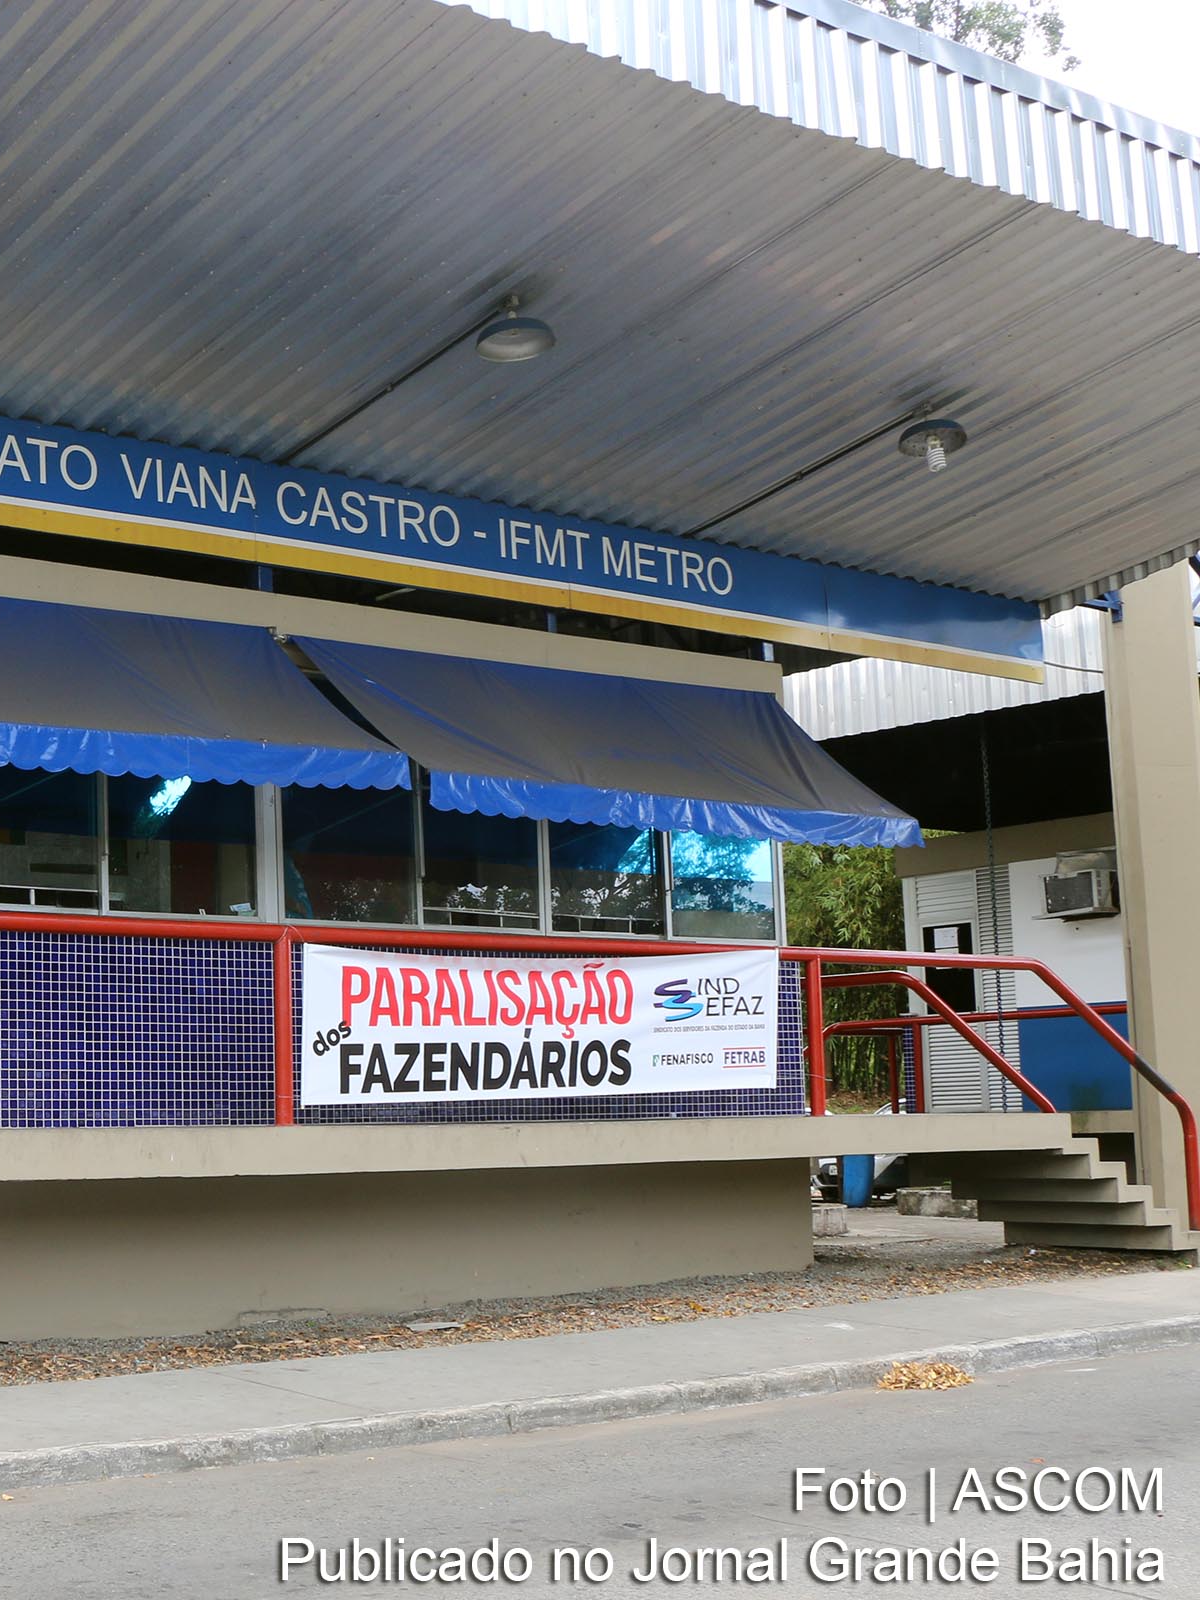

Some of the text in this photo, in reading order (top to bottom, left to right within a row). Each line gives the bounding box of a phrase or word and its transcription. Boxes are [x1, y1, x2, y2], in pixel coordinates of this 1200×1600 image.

[120, 453, 256, 514] VIANA
[276, 481, 460, 547] CASTRO
[498, 518, 590, 570] IFMT
[602, 536, 733, 596] METRO
[341, 962, 634, 1039] PARALISAÇÃO
[312, 1019, 632, 1094] dos FAZENDÁRIOS
[661, 1050, 766, 1066] FENAFISCO FETRAB
